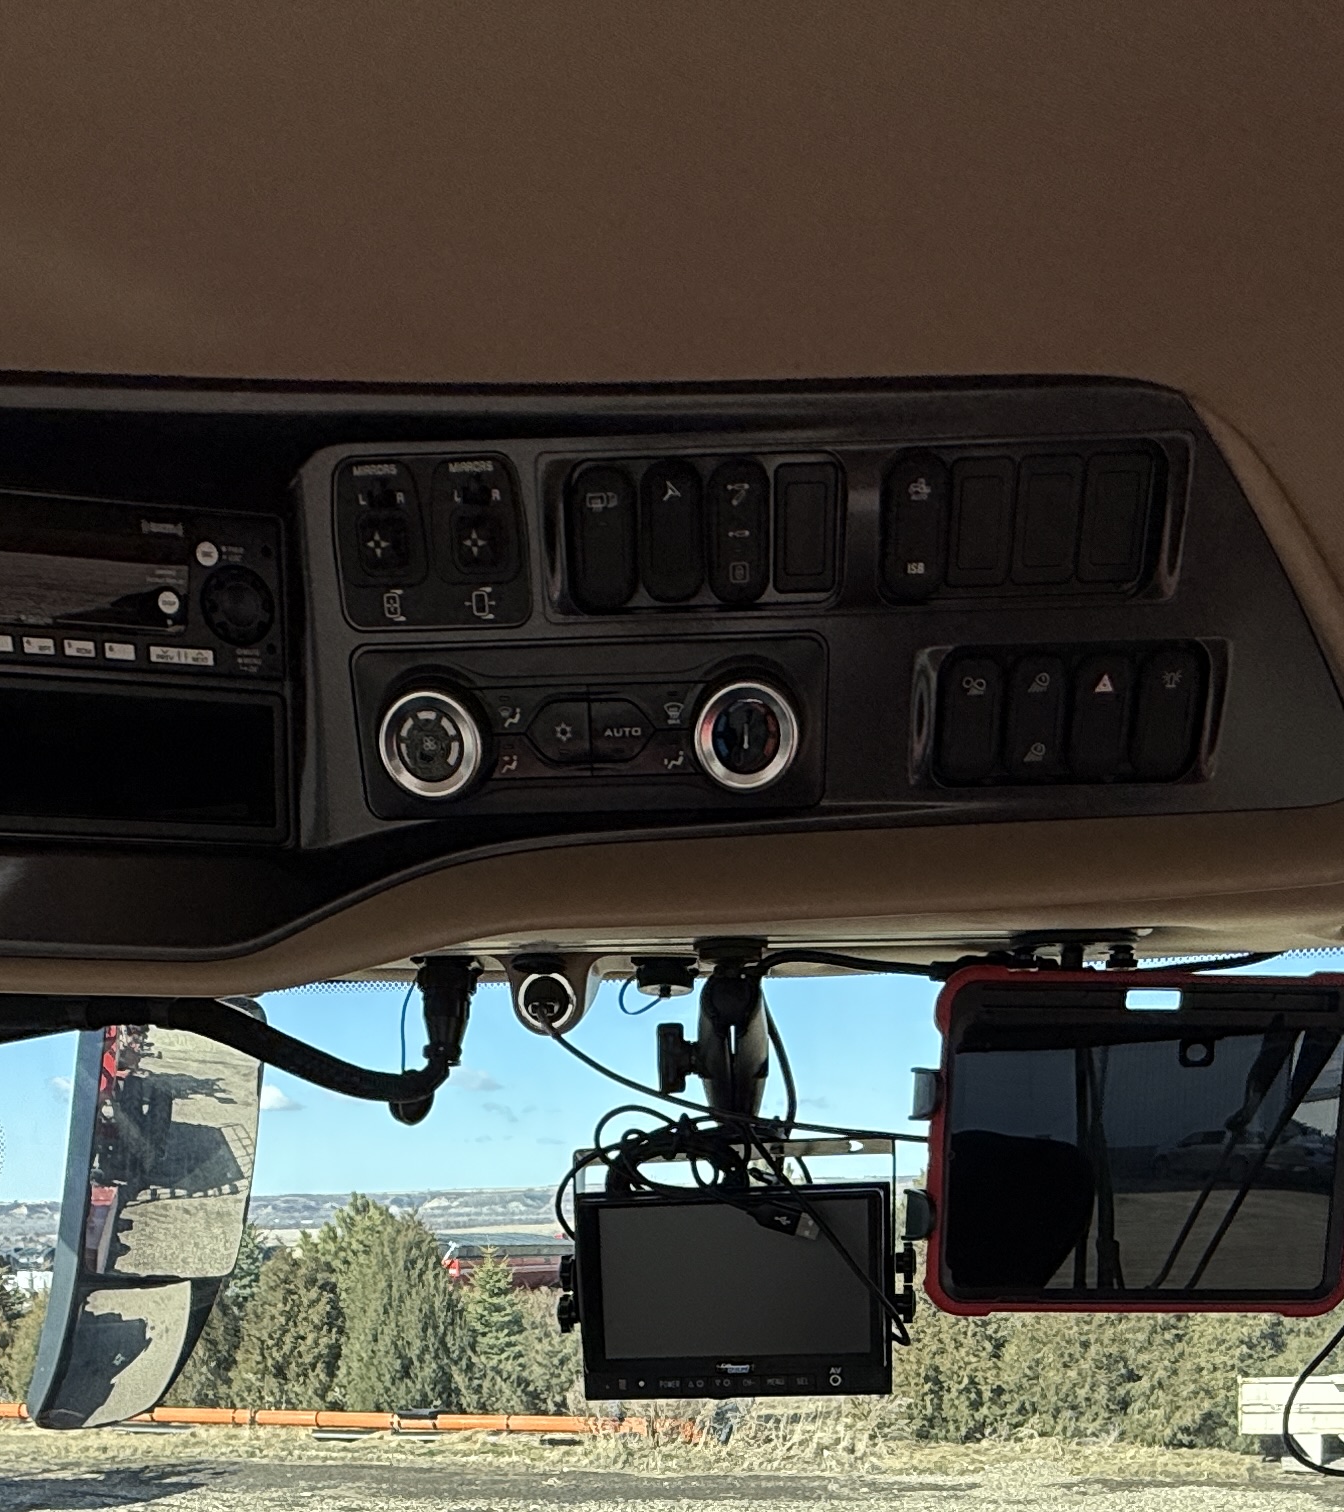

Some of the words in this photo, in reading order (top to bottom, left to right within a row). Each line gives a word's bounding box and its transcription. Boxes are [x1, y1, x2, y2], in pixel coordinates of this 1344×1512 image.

[352, 463, 397, 476] MIRRORS
[448, 460, 494, 473] MIRRORS
[358, 493, 367, 505] L
[396, 491, 405, 504] R
[491, 488, 501, 500] R
[604, 727, 642, 738] AUTO
